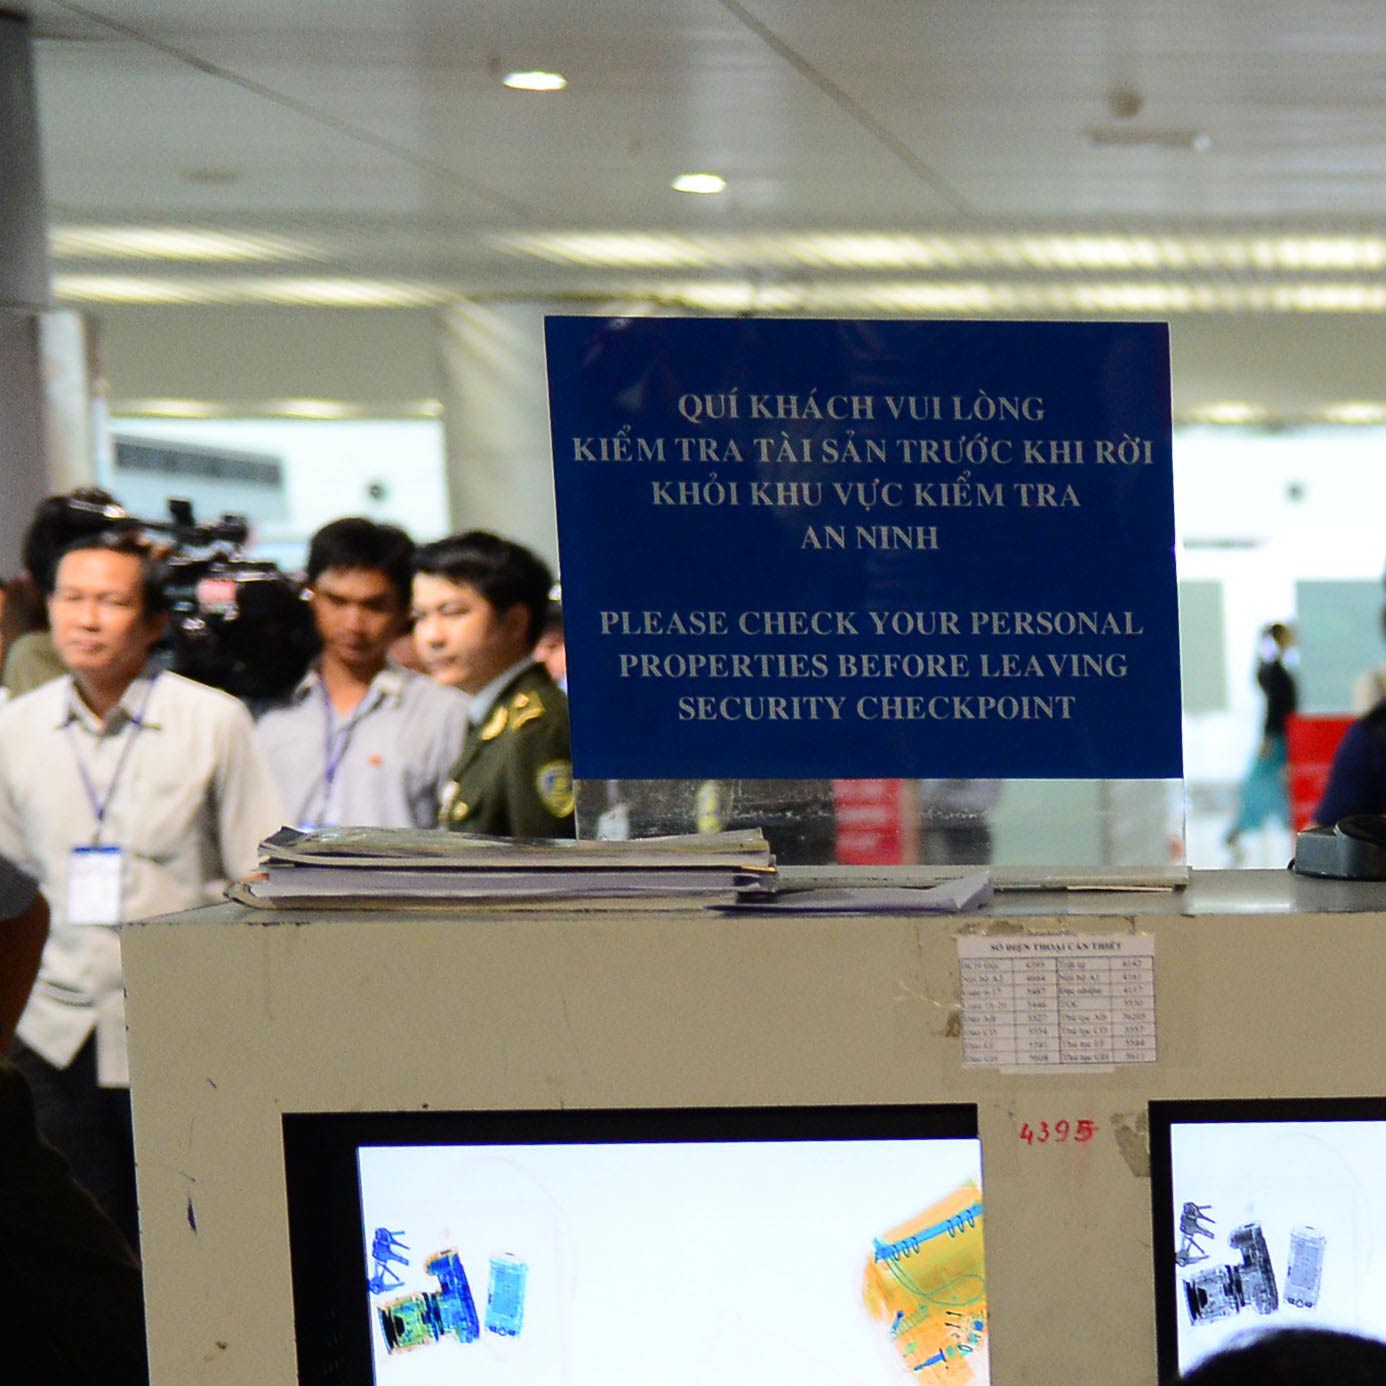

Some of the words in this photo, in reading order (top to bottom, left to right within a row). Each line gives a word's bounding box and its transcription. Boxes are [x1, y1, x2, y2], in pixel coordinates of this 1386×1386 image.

[679, 388, 738, 423] QUÍ
[751, 389, 873, 419] KHÁCH
[885, 397, 940, 419] VUI
[954, 390, 1043, 420] LÒNG
[573, 426, 665, 461] KIỂM
[675, 438, 743, 462] TRA
[754, 432, 811, 462] TÀI
[823, 431, 885, 462] SẢN
[897, 434, 1011, 463] TRƯỚC
[1024, 441, 1083, 463] KHI
[1096, 434, 1152, 464] RỜI
[652, 473, 738, 504] KHỎI
[752, 483, 821, 505] KHU
[833, 479, 901, 510] VỰC
[915, 471, 1003, 506] KIỂM
[1014, 484, 1080, 506] TRA
[802, 526, 844, 548] AN
[856, 526, 937, 549] NINH
[601, 612, 727, 634] PLEASE
[739, 612, 858, 634] CHECK
[869, 612, 960, 634] YOUR
[972, 612, 1142, 634] PERSONAL
[620, 655, 828, 677] PROPERTIES
[839, 655, 968, 676] BEFORE
[981, 655, 1126, 676] LEAVING
[679, 697, 845, 720] SECURITY
[857, 697, 1075, 719] CHECKPOINT
[1020, 1118, 1099, 1145] 4395
